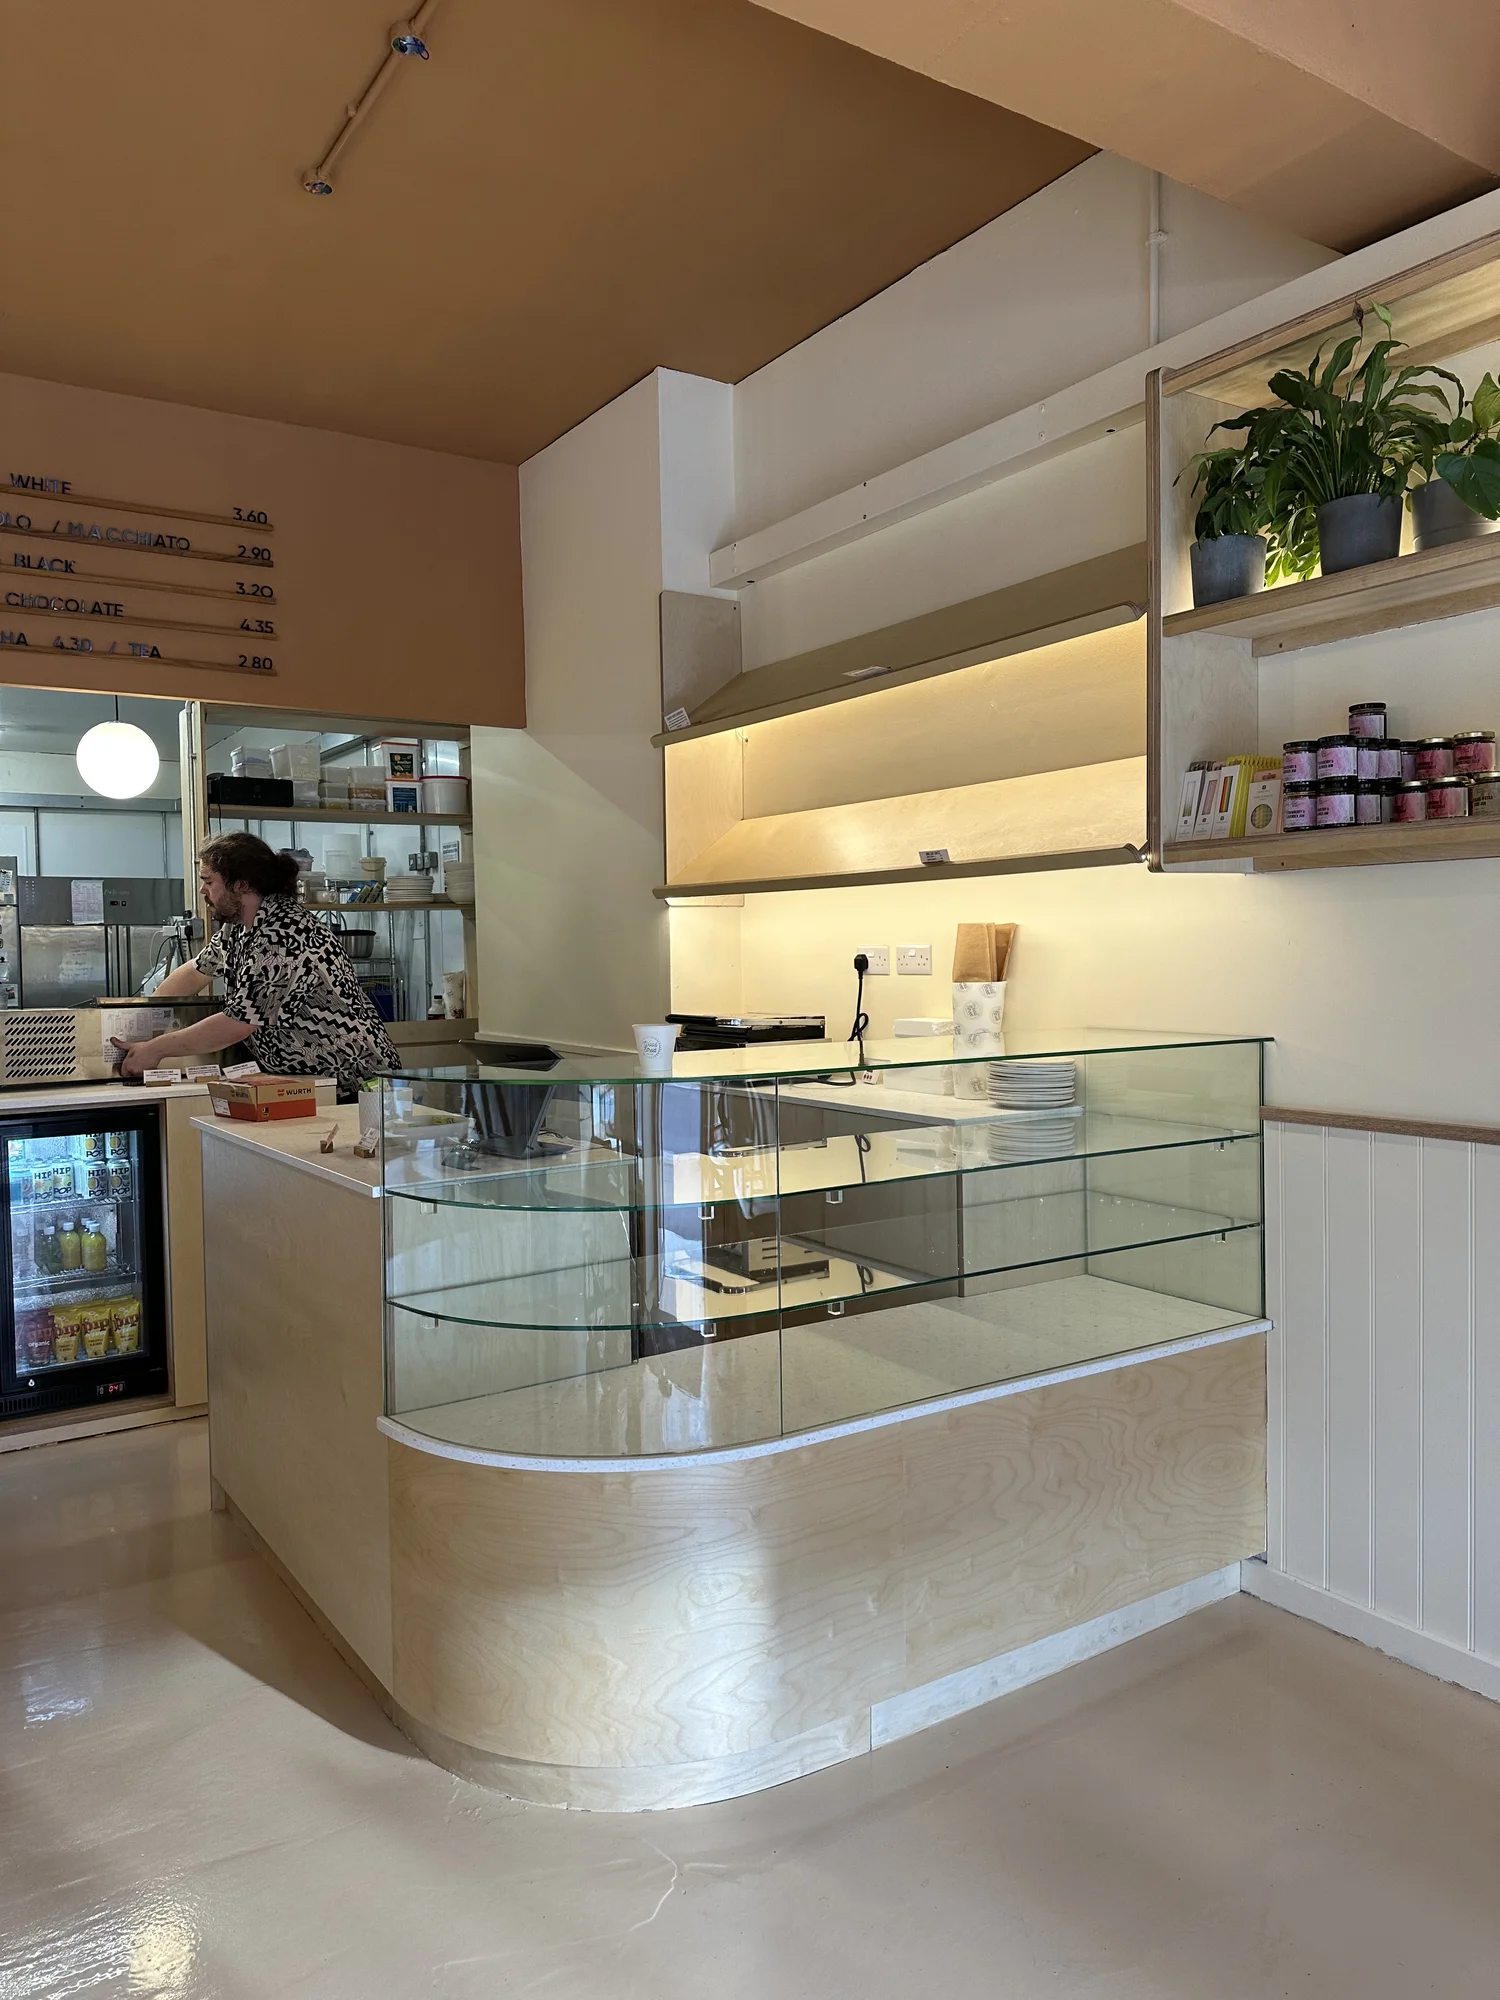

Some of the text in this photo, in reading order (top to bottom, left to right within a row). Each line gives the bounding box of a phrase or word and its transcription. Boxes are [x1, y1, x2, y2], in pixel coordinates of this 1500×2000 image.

[10, 473, 267, 524] WHITE 3.60
[68, 521, 190, 550] MACCHIATO
[238, 545, 271, 561] 2.90
[14, 553, 273, 598] BLACK 3.20
[5, 592, 273, 633] CHOCOLATE 4.35
[53, 636, 93, 652] 4.30
[128, 642, 161, 659] TEA
[53, 1167, 71, 1175] HIP
[89, 1189, 107, 1197] POP
[28, 1340, 50, 1348] organic
